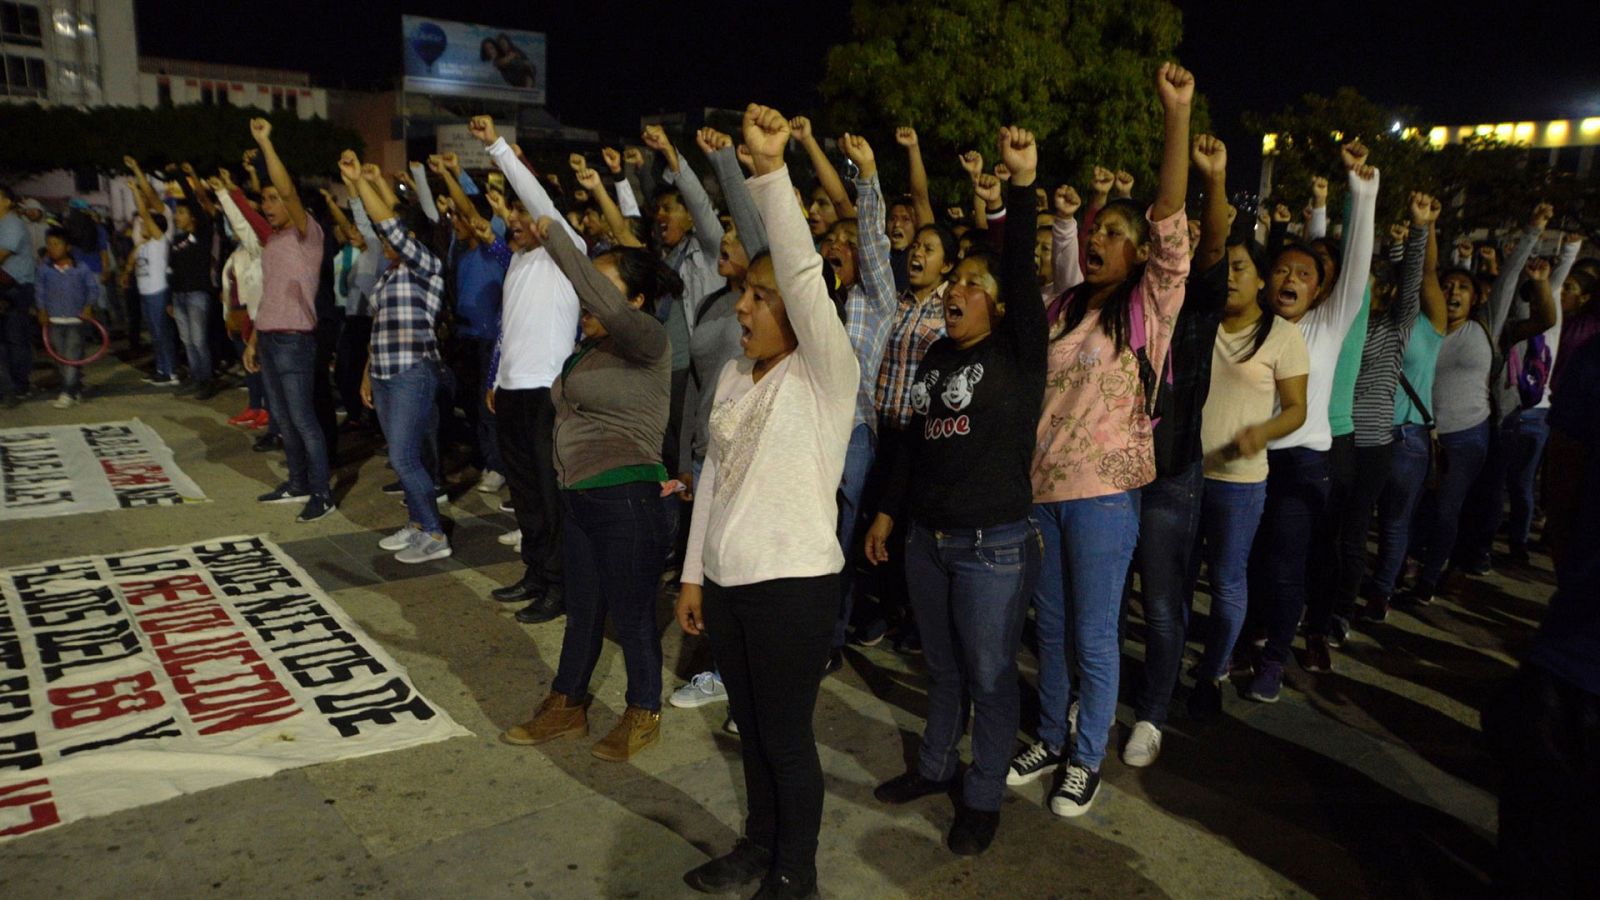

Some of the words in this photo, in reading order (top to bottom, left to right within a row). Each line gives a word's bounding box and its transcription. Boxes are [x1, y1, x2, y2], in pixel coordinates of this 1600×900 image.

[8, 559, 124, 628] HIJOS
[103, 549, 192, 577] LA
[190, 537, 303, 597] SOMOS
[34, 618, 144, 684] DEL
[118, 573, 304, 736] REVOLUCION
[233, 593, 388, 688] NIETOS
[47, 670, 167, 730] 68
[313, 676, 437, 738] DE
[59, 716, 183, 757] Y
